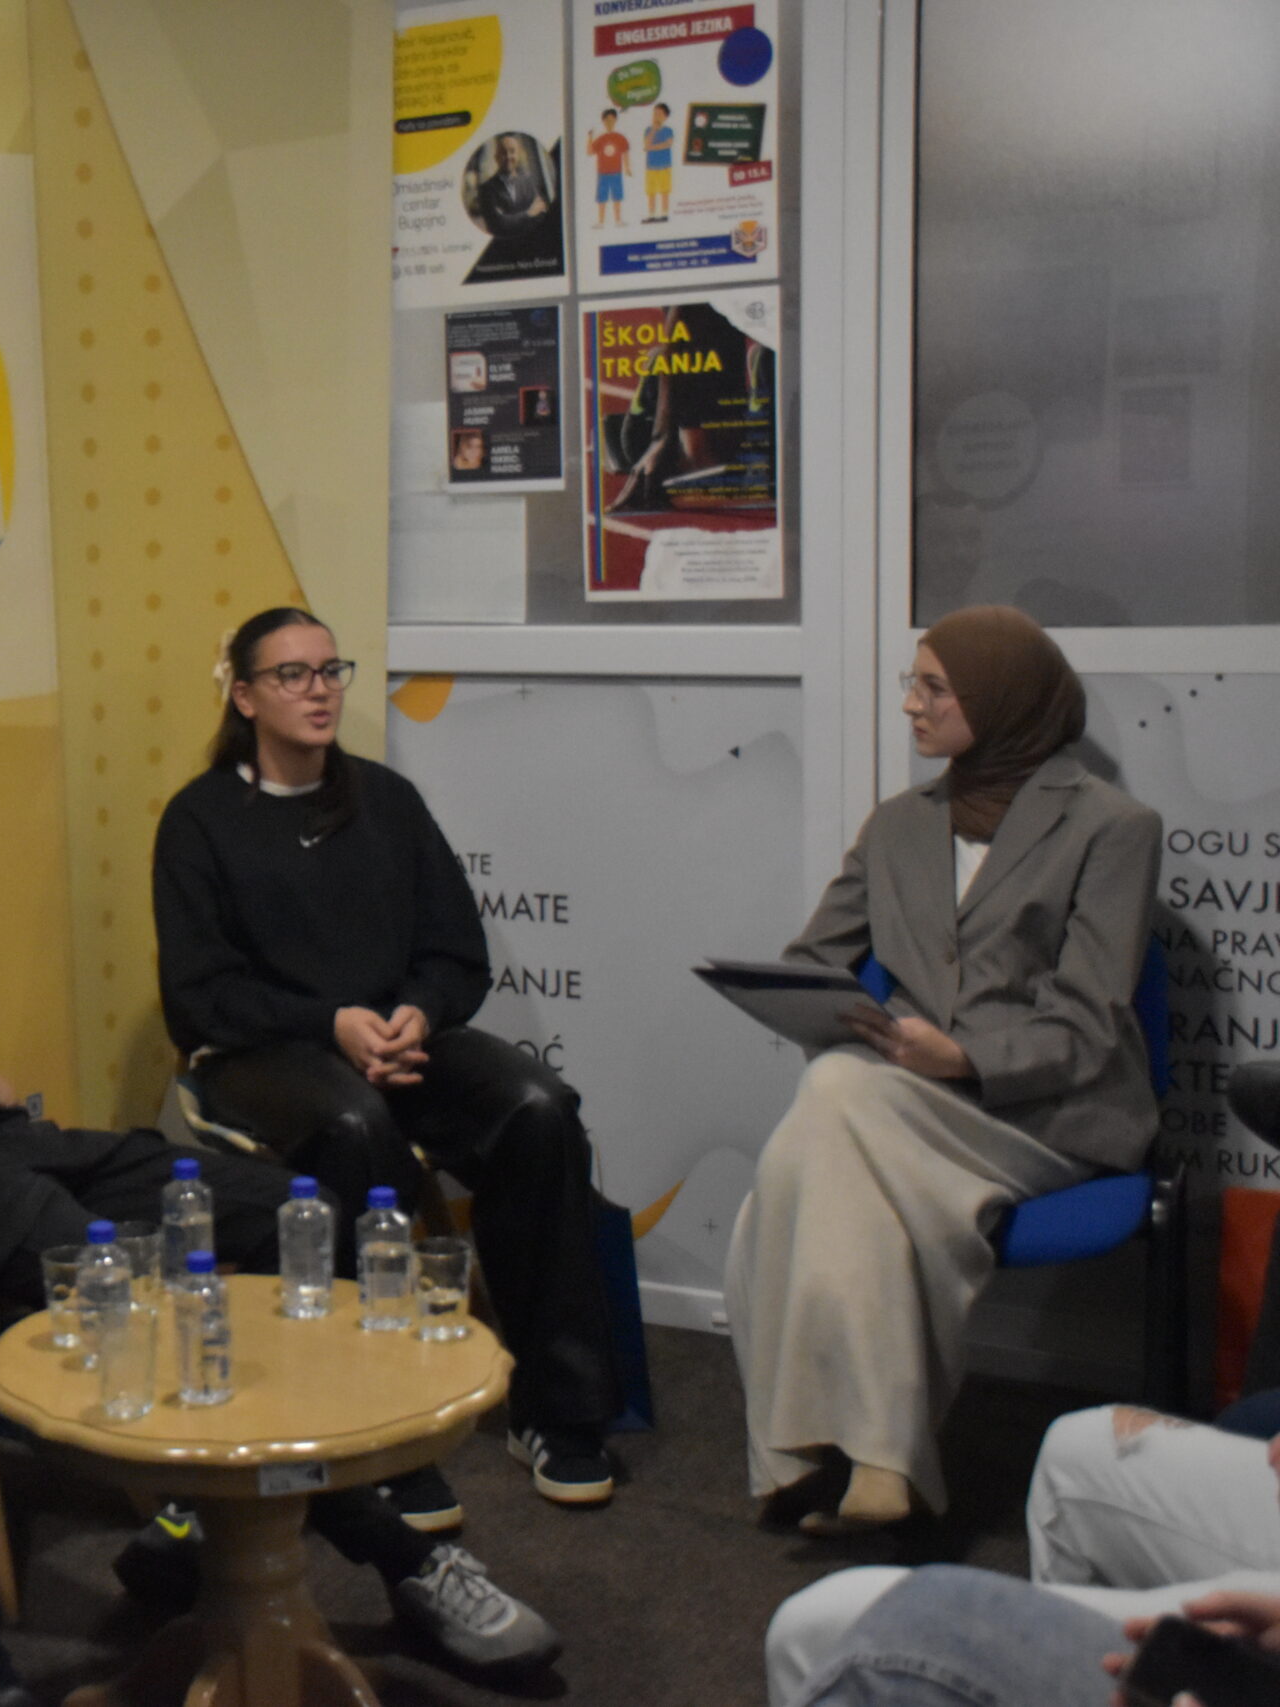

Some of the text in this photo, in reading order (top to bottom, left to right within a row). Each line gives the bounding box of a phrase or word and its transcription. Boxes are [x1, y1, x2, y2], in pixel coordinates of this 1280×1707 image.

[615, 16, 733, 46] ENGLESKOG JEZIKA
[602, 321, 691, 348] ŠKOLA
[602, 350, 723, 378] TRČANJA
